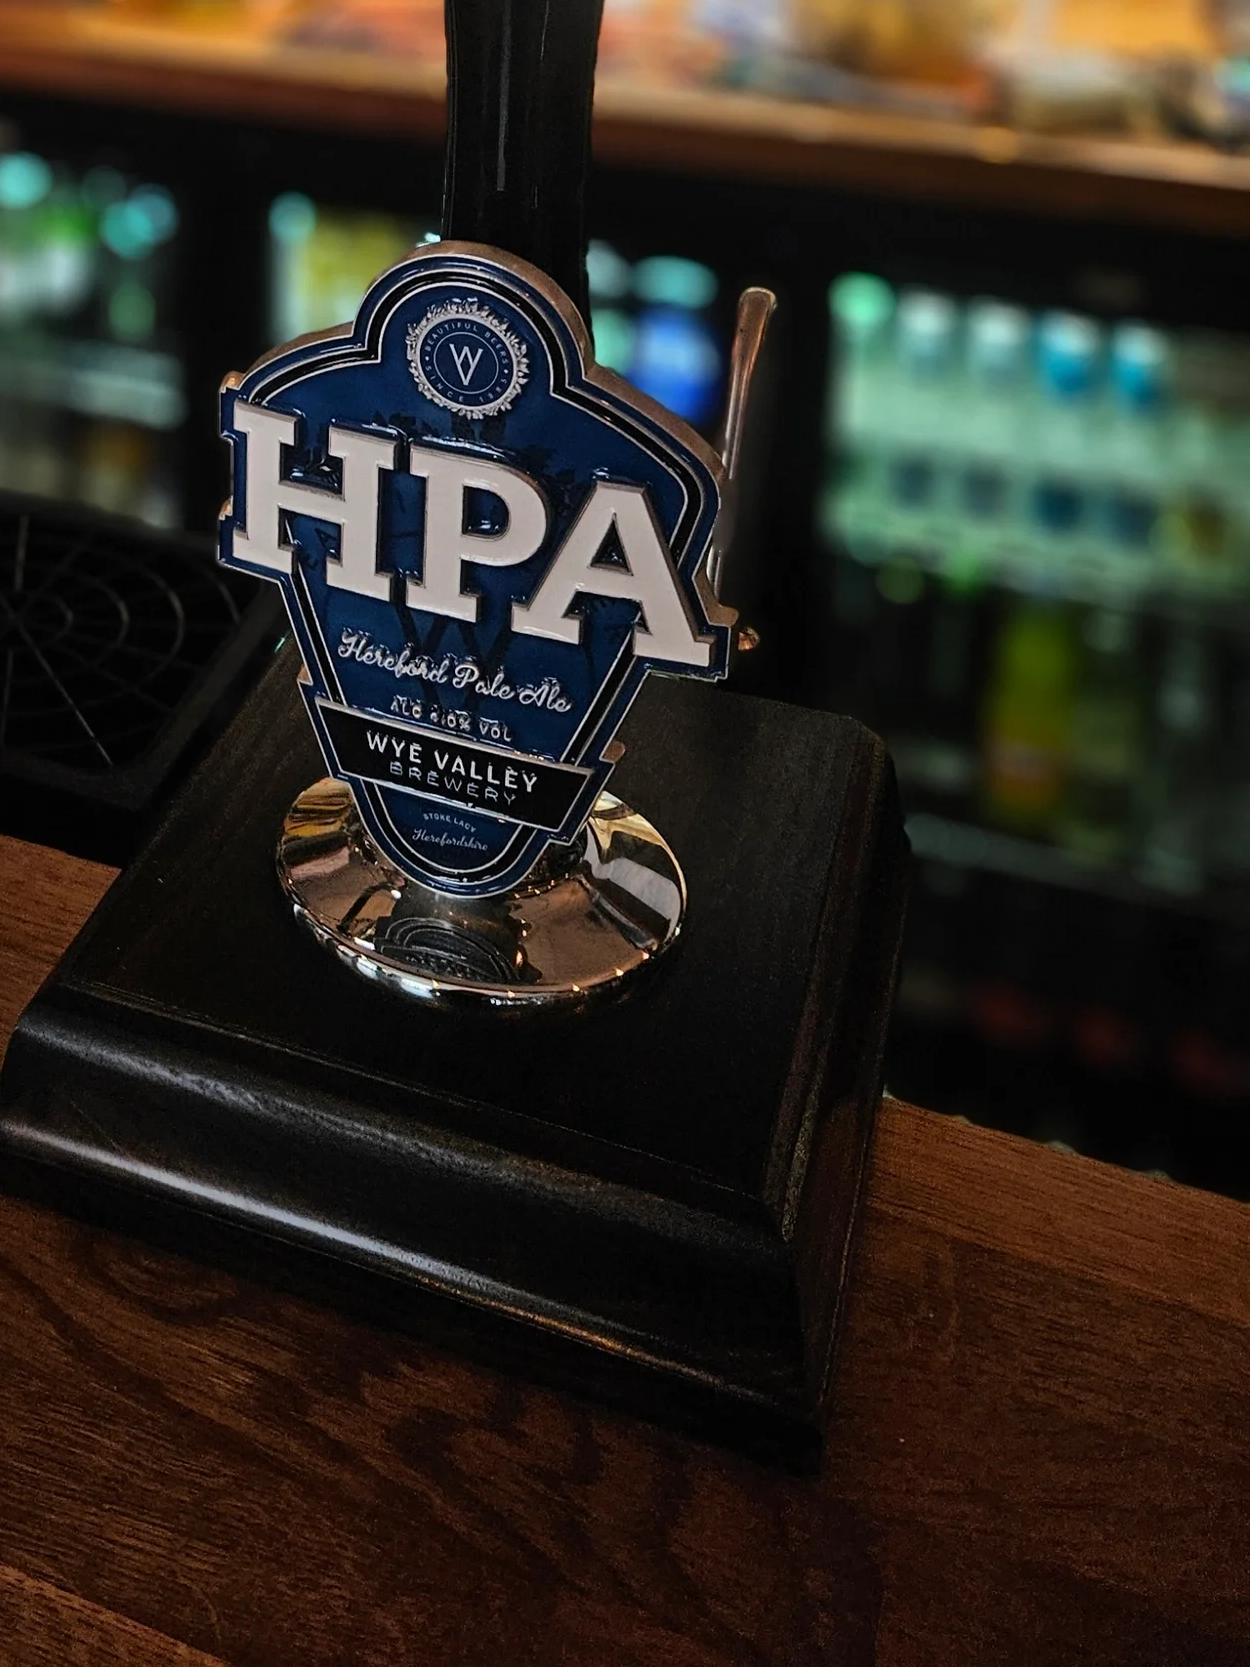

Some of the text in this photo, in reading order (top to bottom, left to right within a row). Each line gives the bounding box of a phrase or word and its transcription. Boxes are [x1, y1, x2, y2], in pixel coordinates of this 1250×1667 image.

[425, 322, 509, 364] BEAUTIFUL BEERS
[426, 365, 465, 402] SINCE
[233, 399, 712, 667] HPA
[338, 629, 572, 712] Hereford Pale Ale
[479, 717, 512, 742] VOL
[366, 730, 537, 793] WYE VALLEY
[389, 761, 516, 806] BREWERY
[411, 828, 489, 851] Herefordshire
[423, 812, 477, 832] STOKE LACY
